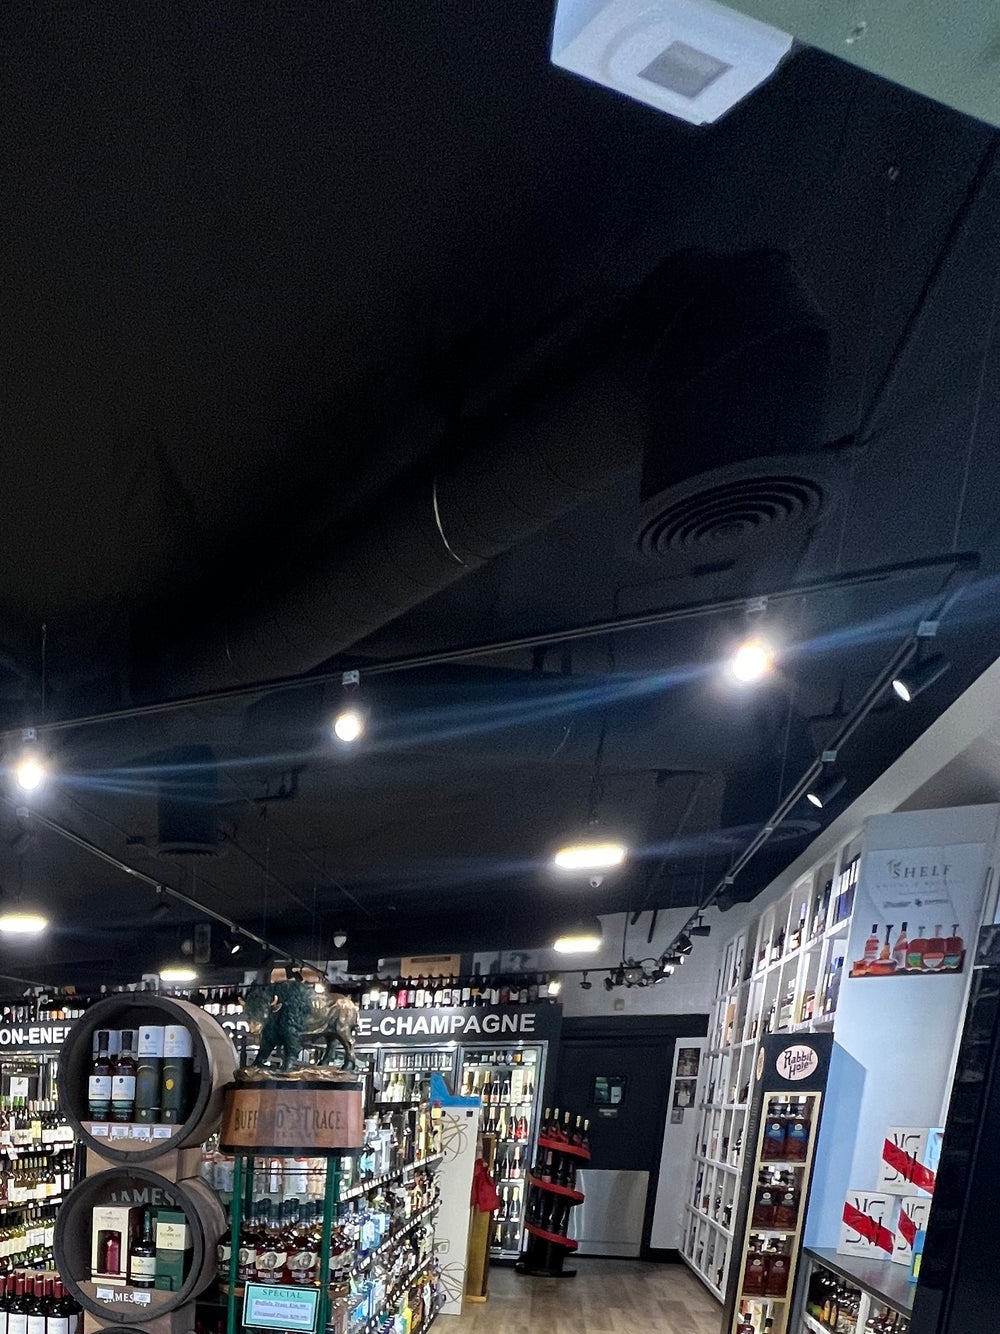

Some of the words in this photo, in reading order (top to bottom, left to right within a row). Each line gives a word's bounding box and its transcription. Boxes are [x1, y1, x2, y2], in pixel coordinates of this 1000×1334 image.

[892, 865, 952, 878] SHELF
[352, 1013, 536, 1036] E-CHAMPAGNE
[784, 1050, 813, 1069] Rabbit
[789, 1062, 809, 1079] Hole
[234, 1108, 284, 1131] BUFFO
[300, 1106, 342, 1135] TRACE
[262, 1289, 303, 1299] SPECIAL
